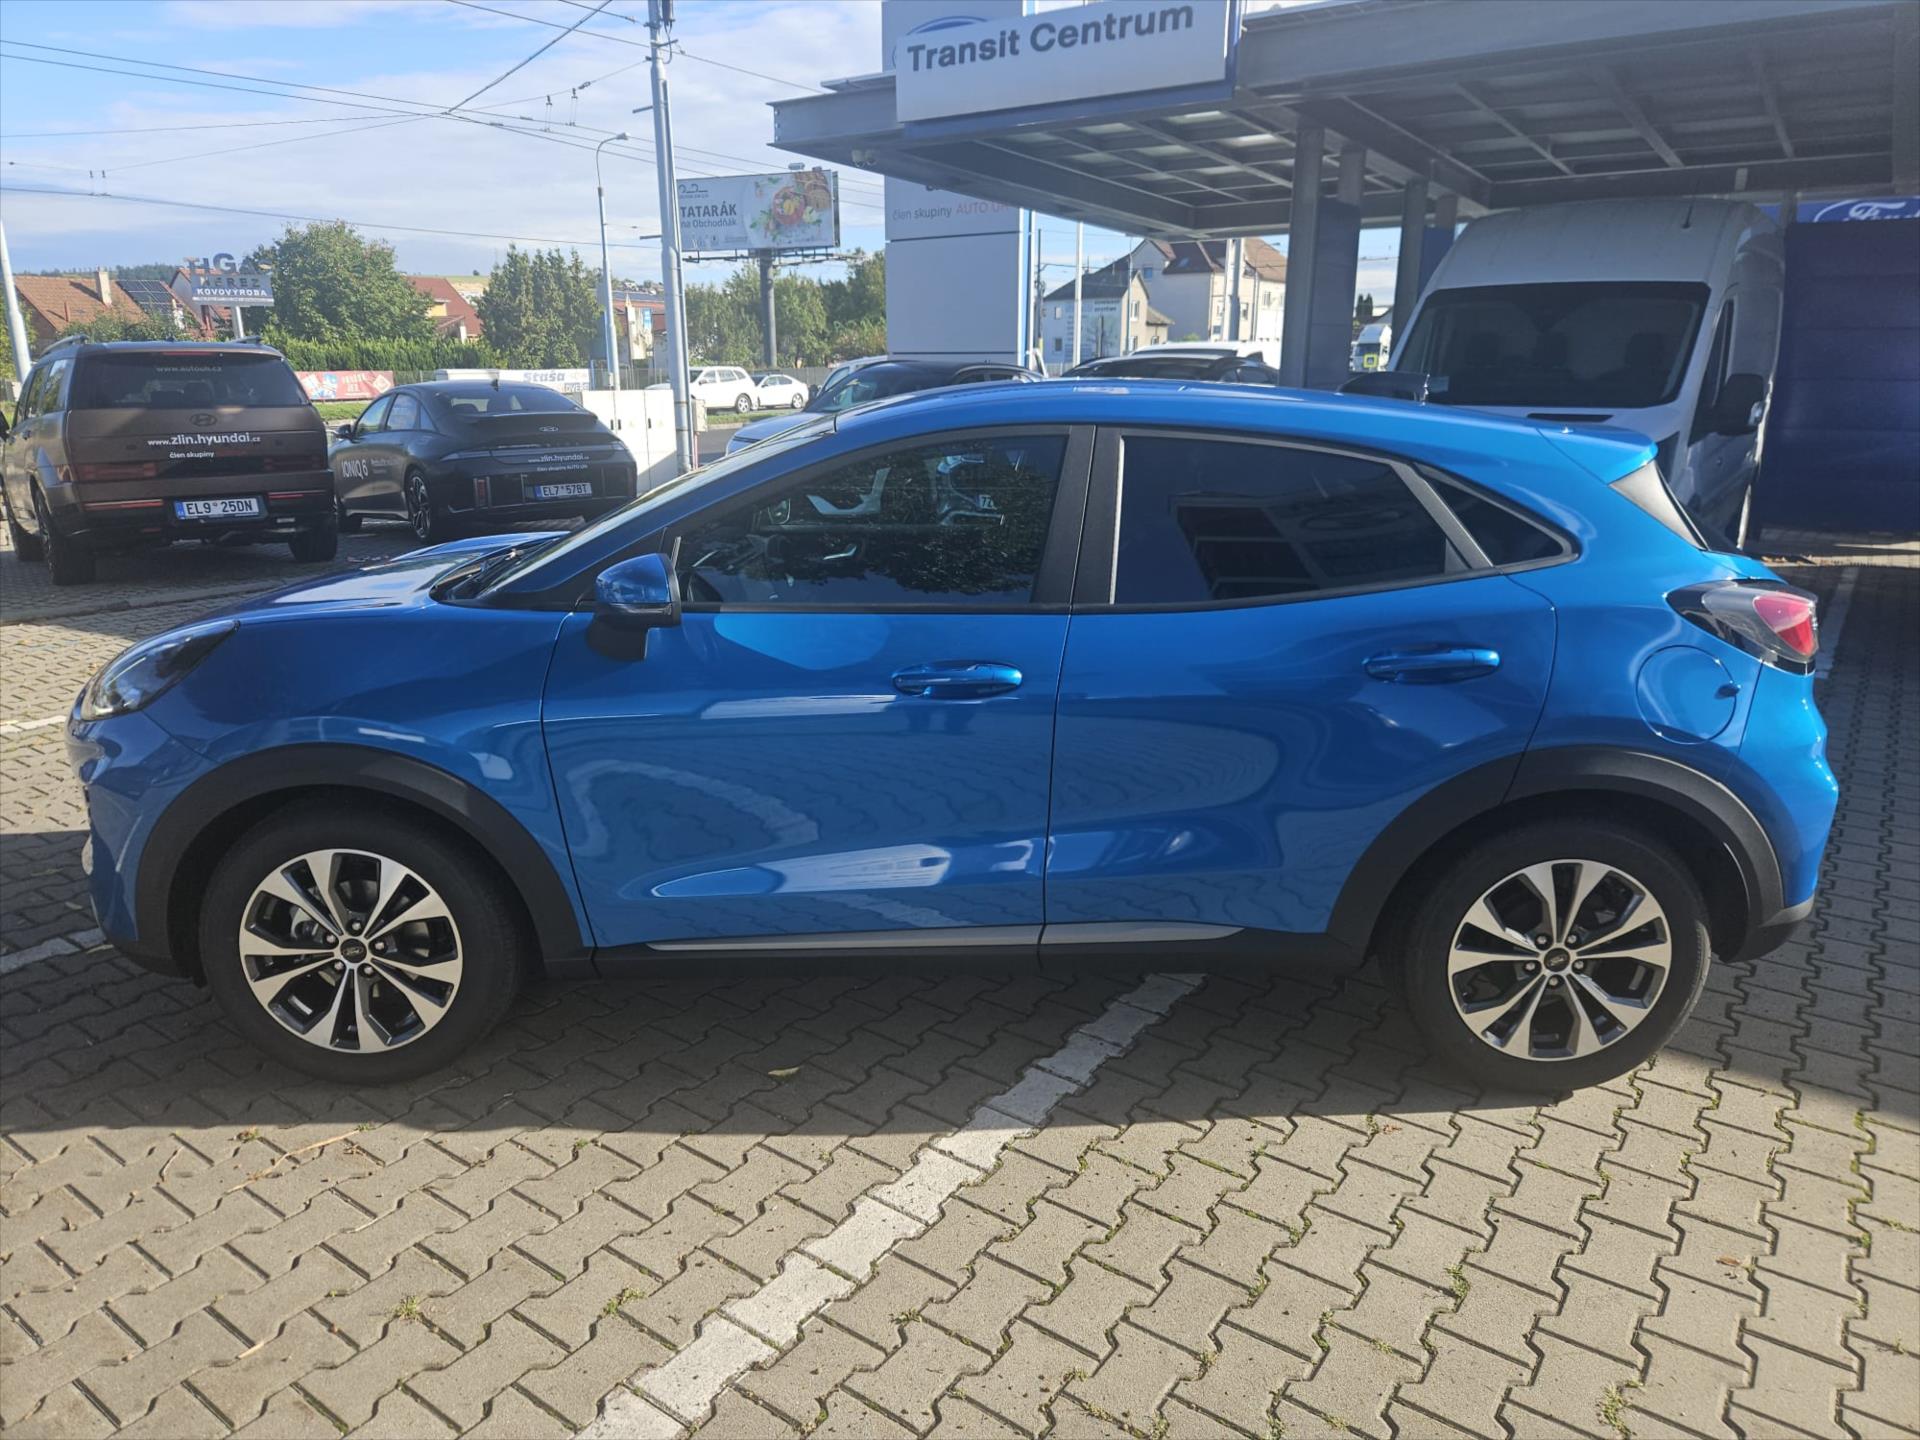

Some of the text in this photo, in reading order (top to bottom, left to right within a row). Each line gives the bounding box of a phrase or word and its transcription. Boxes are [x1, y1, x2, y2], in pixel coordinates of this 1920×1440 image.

[907, 5, 1194, 72] Transit Centrum
[680, 201, 737, 218] TATARÁK
[914, 207, 952, 219] skupiny
[956, 202, 988, 214] AUTO
[543, 486, 559, 496] EL7
[186, 500, 253, 515] EL9 25DN
